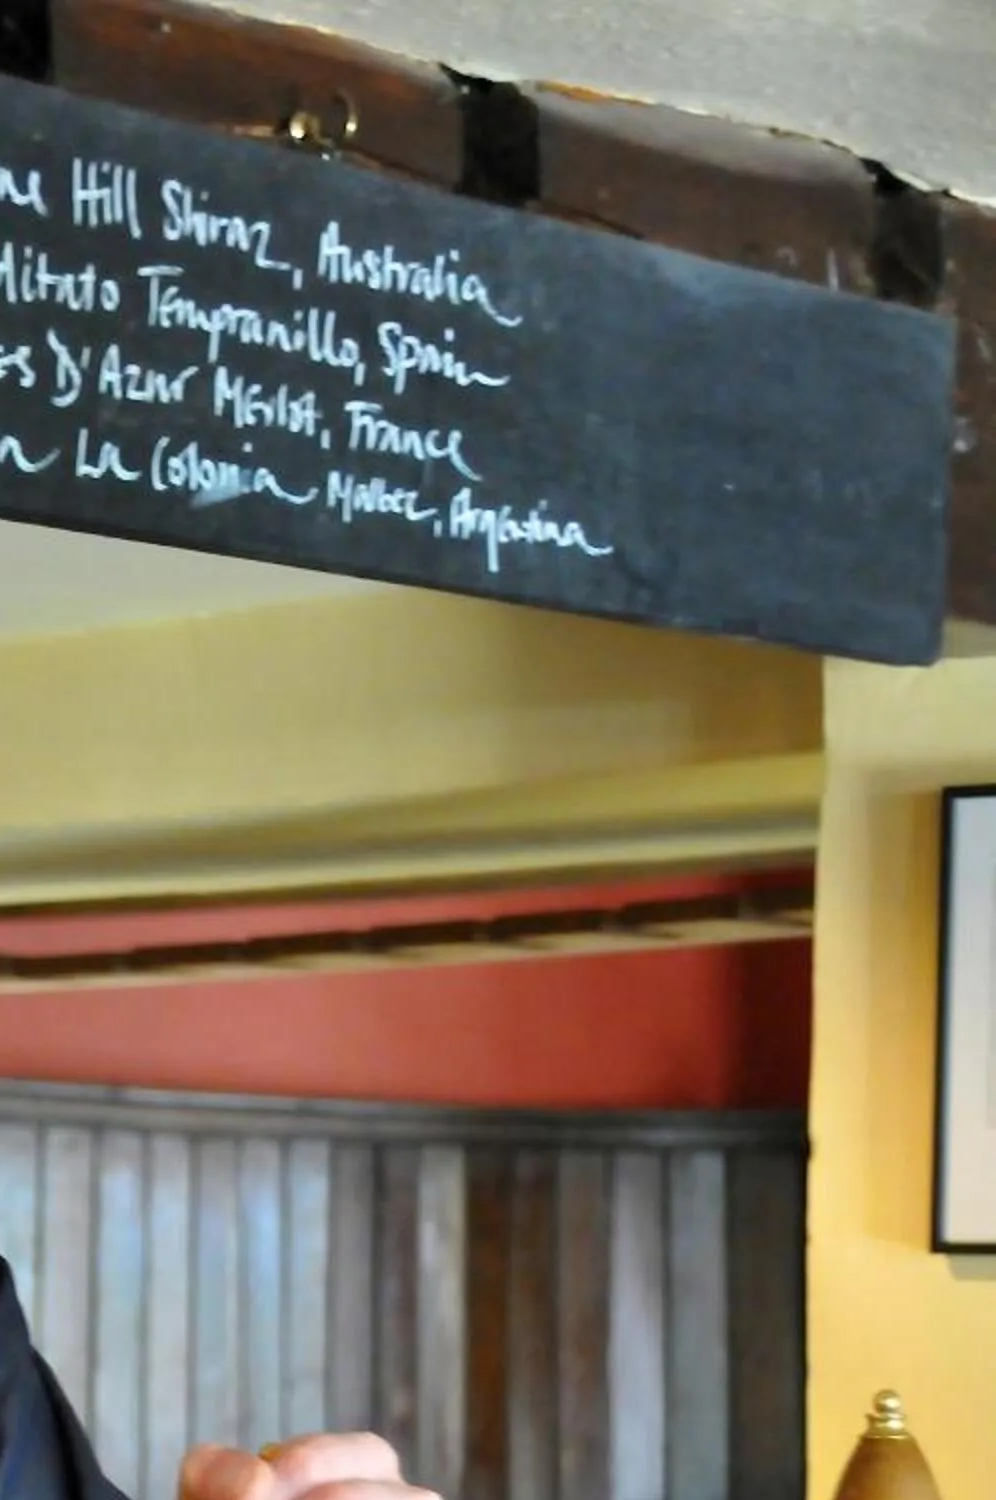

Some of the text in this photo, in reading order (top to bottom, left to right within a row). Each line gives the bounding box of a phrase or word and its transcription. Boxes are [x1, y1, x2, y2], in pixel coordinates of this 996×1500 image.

[71, 156, 143, 240] Hill
[317, 220, 525, 328] Australia
[376, 320, 512, 395] Spain
[74, 427, 142, 481] La
[344, 400, 484, 483] France
